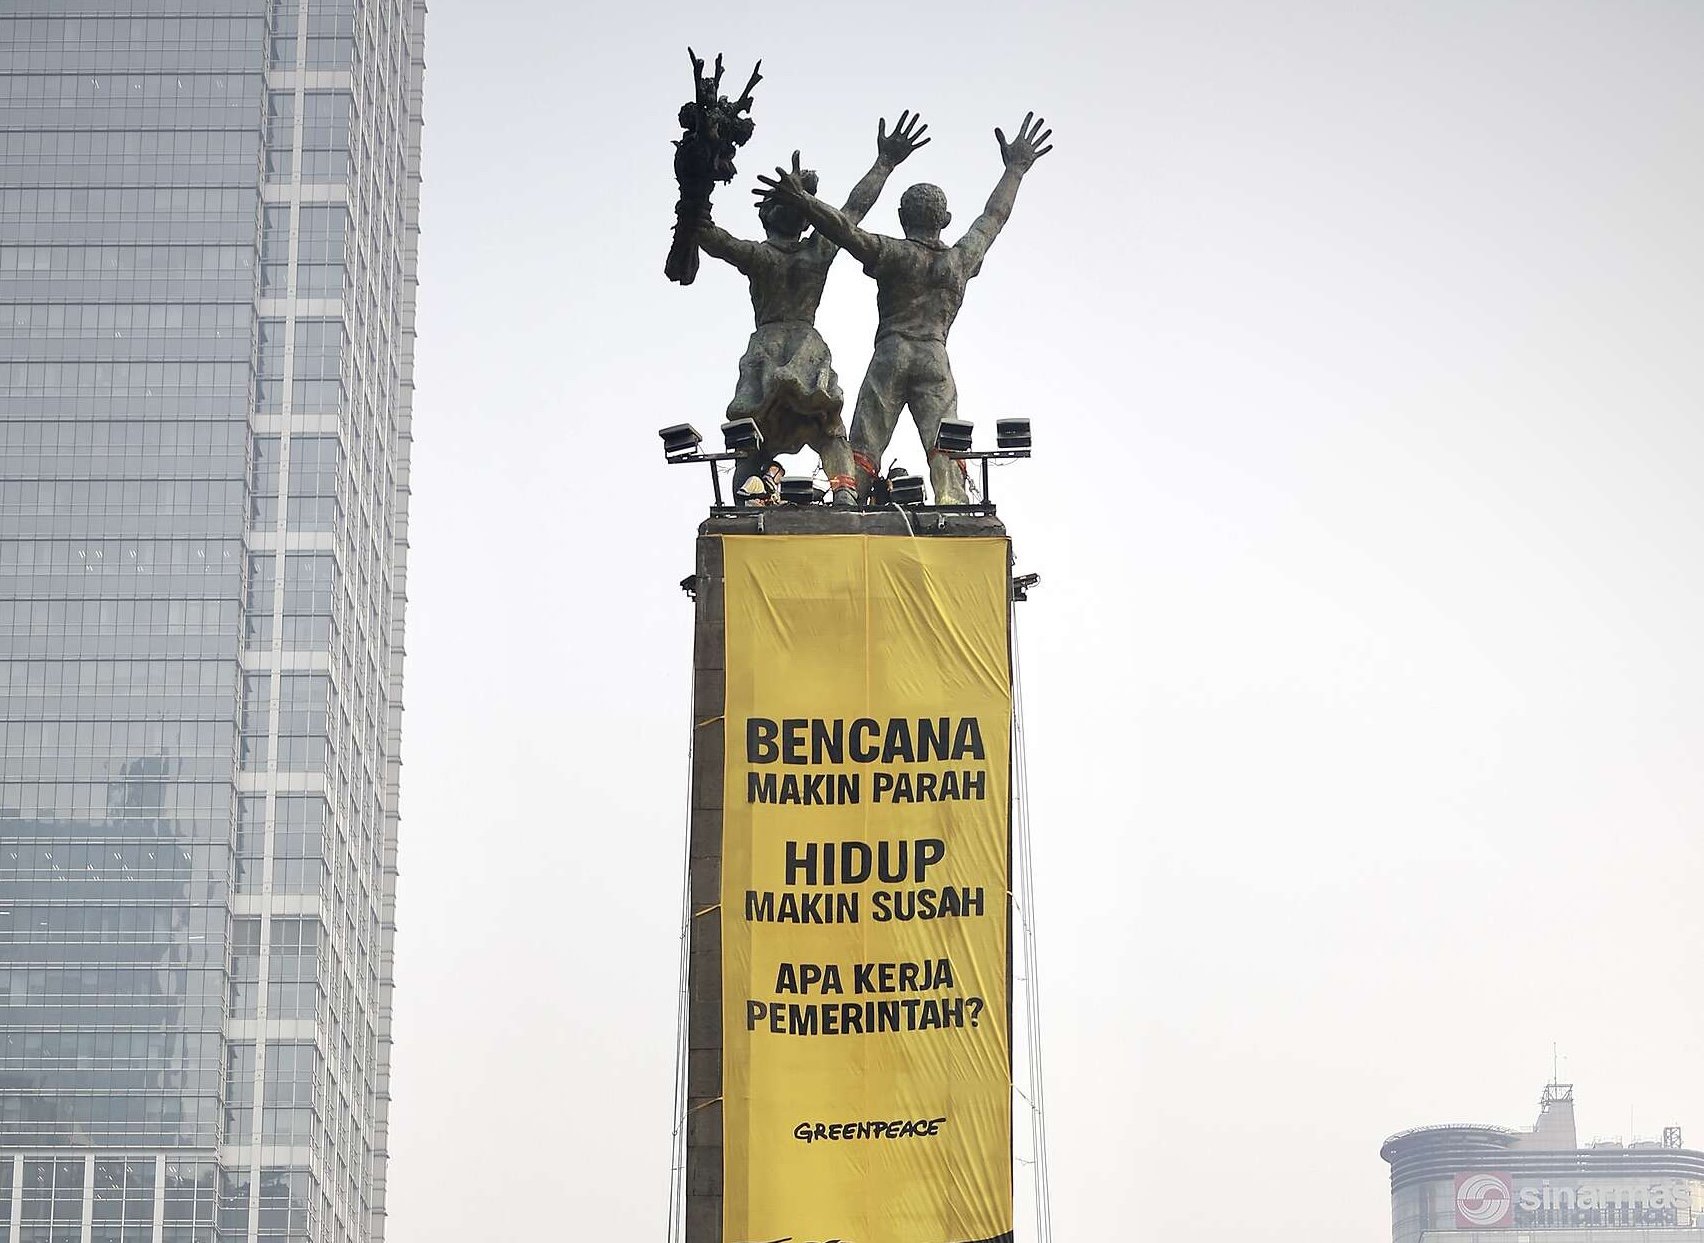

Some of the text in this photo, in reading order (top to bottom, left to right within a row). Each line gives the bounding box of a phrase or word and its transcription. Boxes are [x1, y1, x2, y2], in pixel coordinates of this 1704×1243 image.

[746, 717, 985, 764] BENCANA
[747, 771, 985, 804] MAKIN PARAH
[785, 839, 945, 885] HIDUP
[745, 887, 984, 923] MAKIN SUSAH
[775, 959, 953, 994] APA KERJA
[746, 998, 983, 1035] PEMERINTAH?
[793, 1117, 946, 1142] GREENPEACE
[1519, 1180, 1692, 1209] sinarmas
